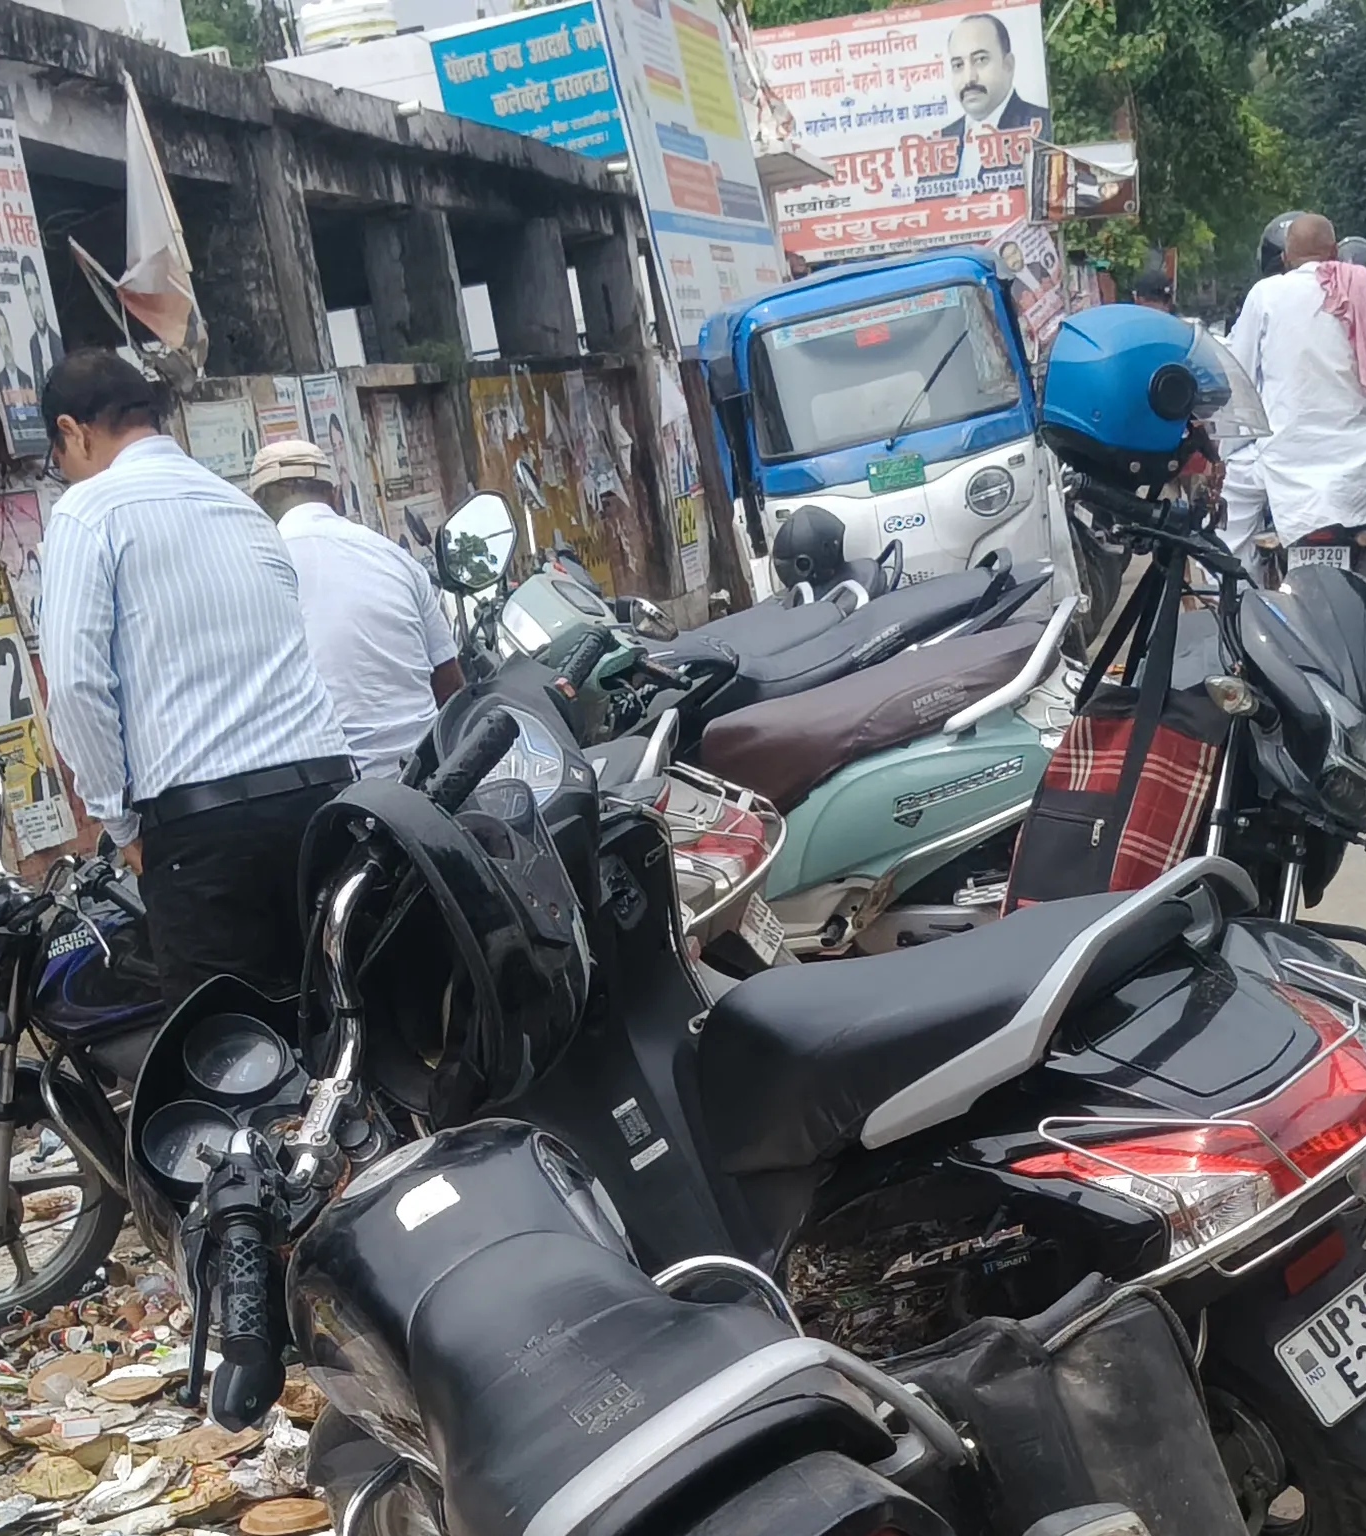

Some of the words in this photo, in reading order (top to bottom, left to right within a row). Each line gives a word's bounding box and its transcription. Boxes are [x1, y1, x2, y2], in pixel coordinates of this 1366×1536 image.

[771, 51, 803, 72] आप
[809, 39, 842, 66] सभी
[847, 30, 918, 61] सम्मानित
[552, 66, 610, 102] लखनऊ
[897, 106, 910, 121] का
[819, 147, 897, 195] हादुर
[898, 128, 960, 178] सिंह
[784, 195, 851, 215] एडवोकेट
[812, 208, 931, 242] संयुक्त
[941, 193, 1013, 223] मंत्री
[3, 202, 38, 247] सिंह
[823, 245, 866, 259] लखनऊ
[868, 241, 886, 255] बार
[949, 229, 993, 244] लखनऊ
[885, 513, 925, 533] GOGO
[47, 936, 96, 960] HONDA
[1305, 1365, 1328, 1387] IND
